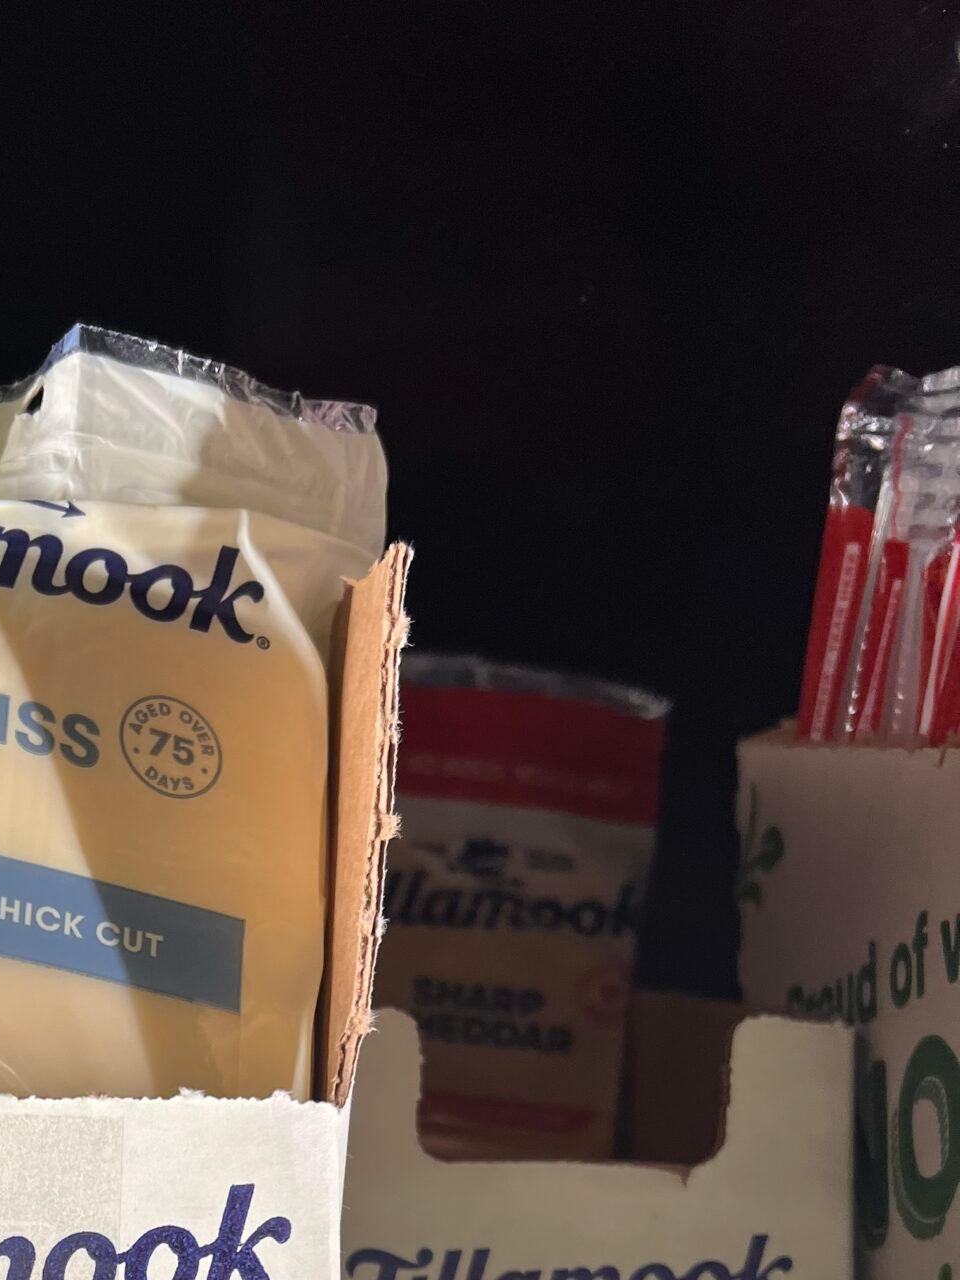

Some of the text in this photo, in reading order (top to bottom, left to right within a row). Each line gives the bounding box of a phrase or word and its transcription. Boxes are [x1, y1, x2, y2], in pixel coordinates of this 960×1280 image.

[128, 702, 215, 756] AGED OVER
[149, 727, 195, 766] 75
[145, 766, 195, 791] DAYS
[95, 920, 164, 960] CUT
[890, 909, 928, 1008] of
